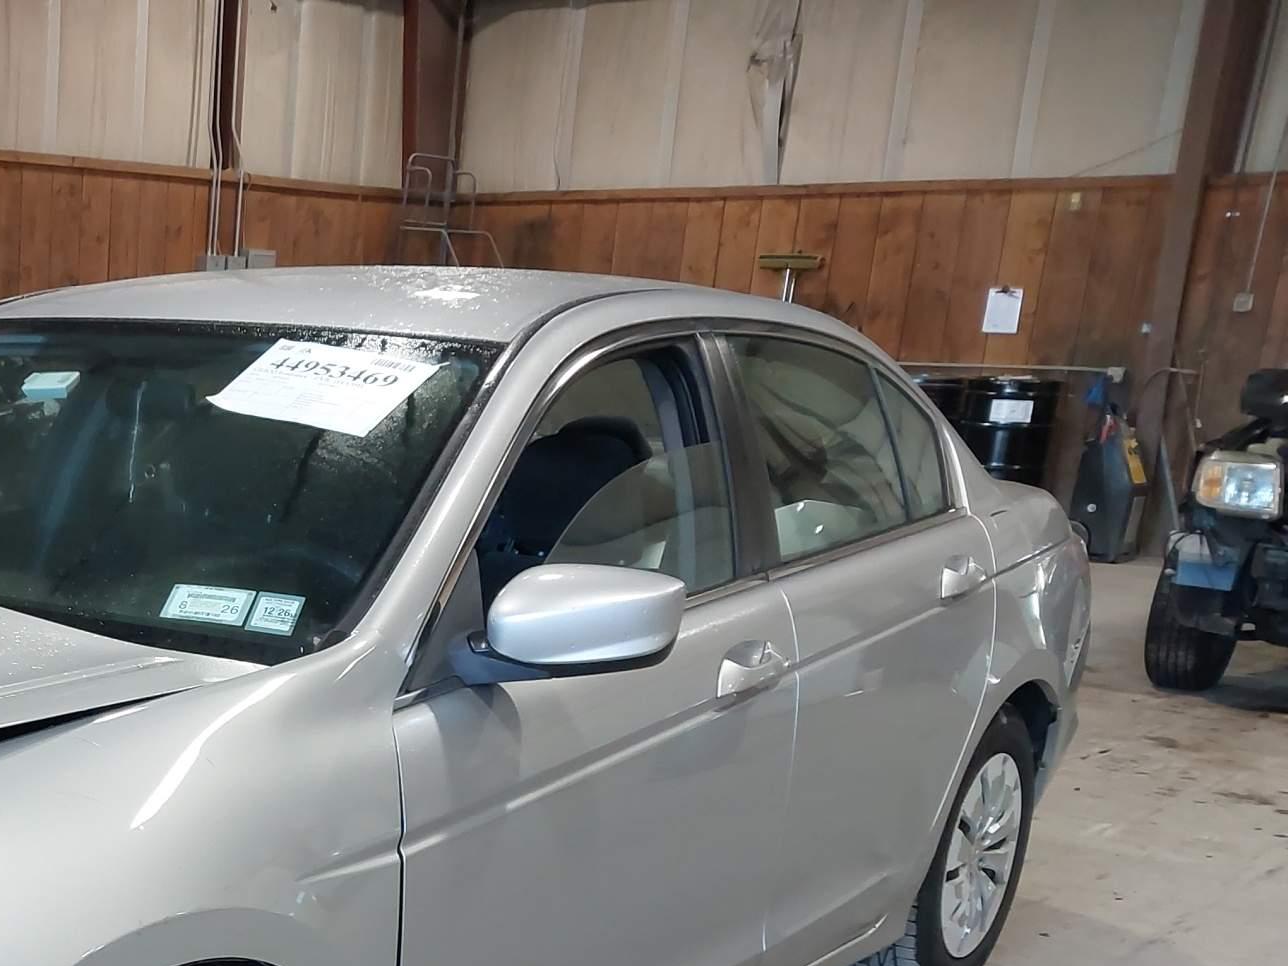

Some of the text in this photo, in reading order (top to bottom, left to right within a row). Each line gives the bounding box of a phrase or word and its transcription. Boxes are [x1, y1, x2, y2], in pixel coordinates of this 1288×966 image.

[270, 357, 399, 388] 44953469
[221, 604, 239, 616] 26
[263, 606, 291, 617] 12 26
